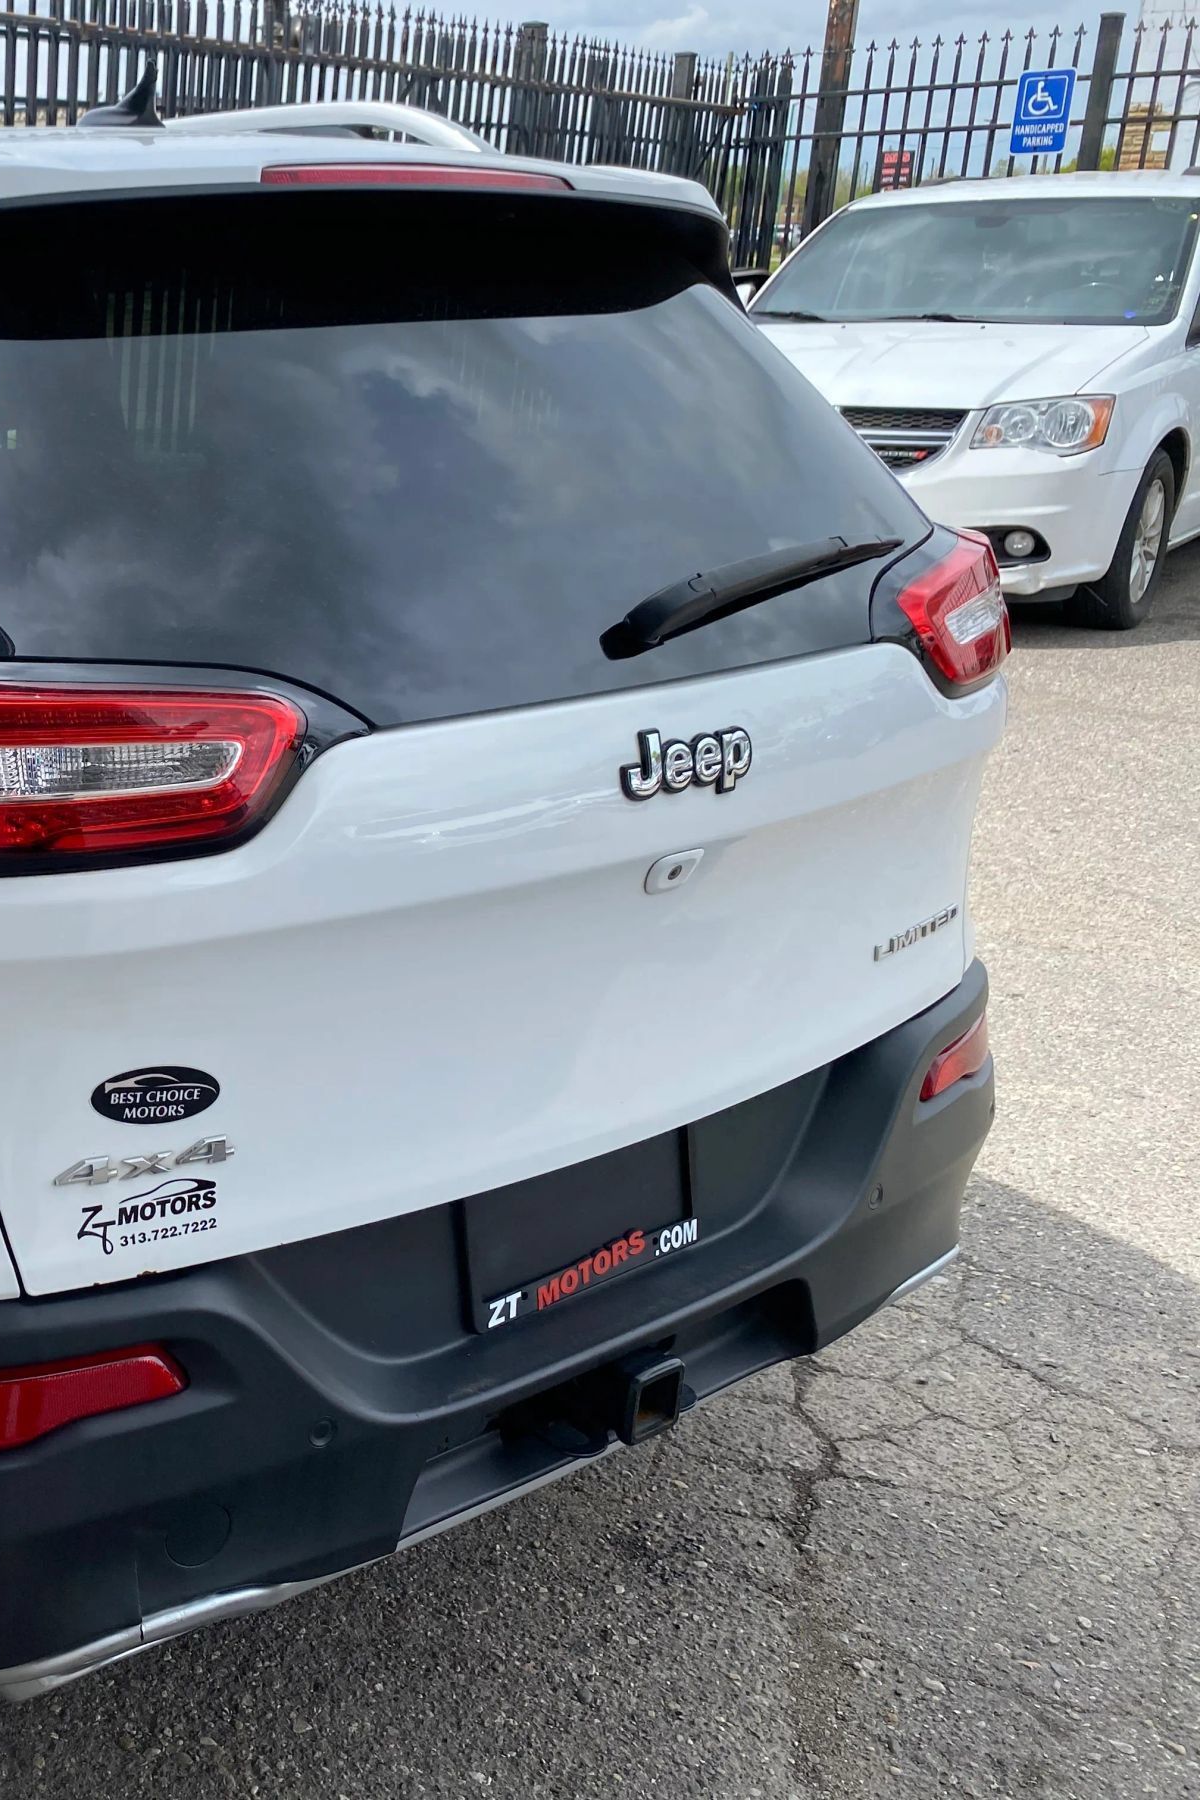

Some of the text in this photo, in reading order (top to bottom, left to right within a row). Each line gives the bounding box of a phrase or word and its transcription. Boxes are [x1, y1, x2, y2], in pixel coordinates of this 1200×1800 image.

[1014, 123, 1065, 135] HANDICAPPED
[1022, 136, 1054, 147] PARKING
[620, 726, 753, 801] Jeep
[873, 903, 958, 962] LIMITED
[110, 1088, 202, 1105] BEST CHOICE
[123, 1104, 185, 1119] MOTORS
[117, 1190, 217, 1227] MOTORS
[119, 1218, 218, 1248] 313.722.7222
[487, 1218, 698, 1330] ZT MOTORS .COM
